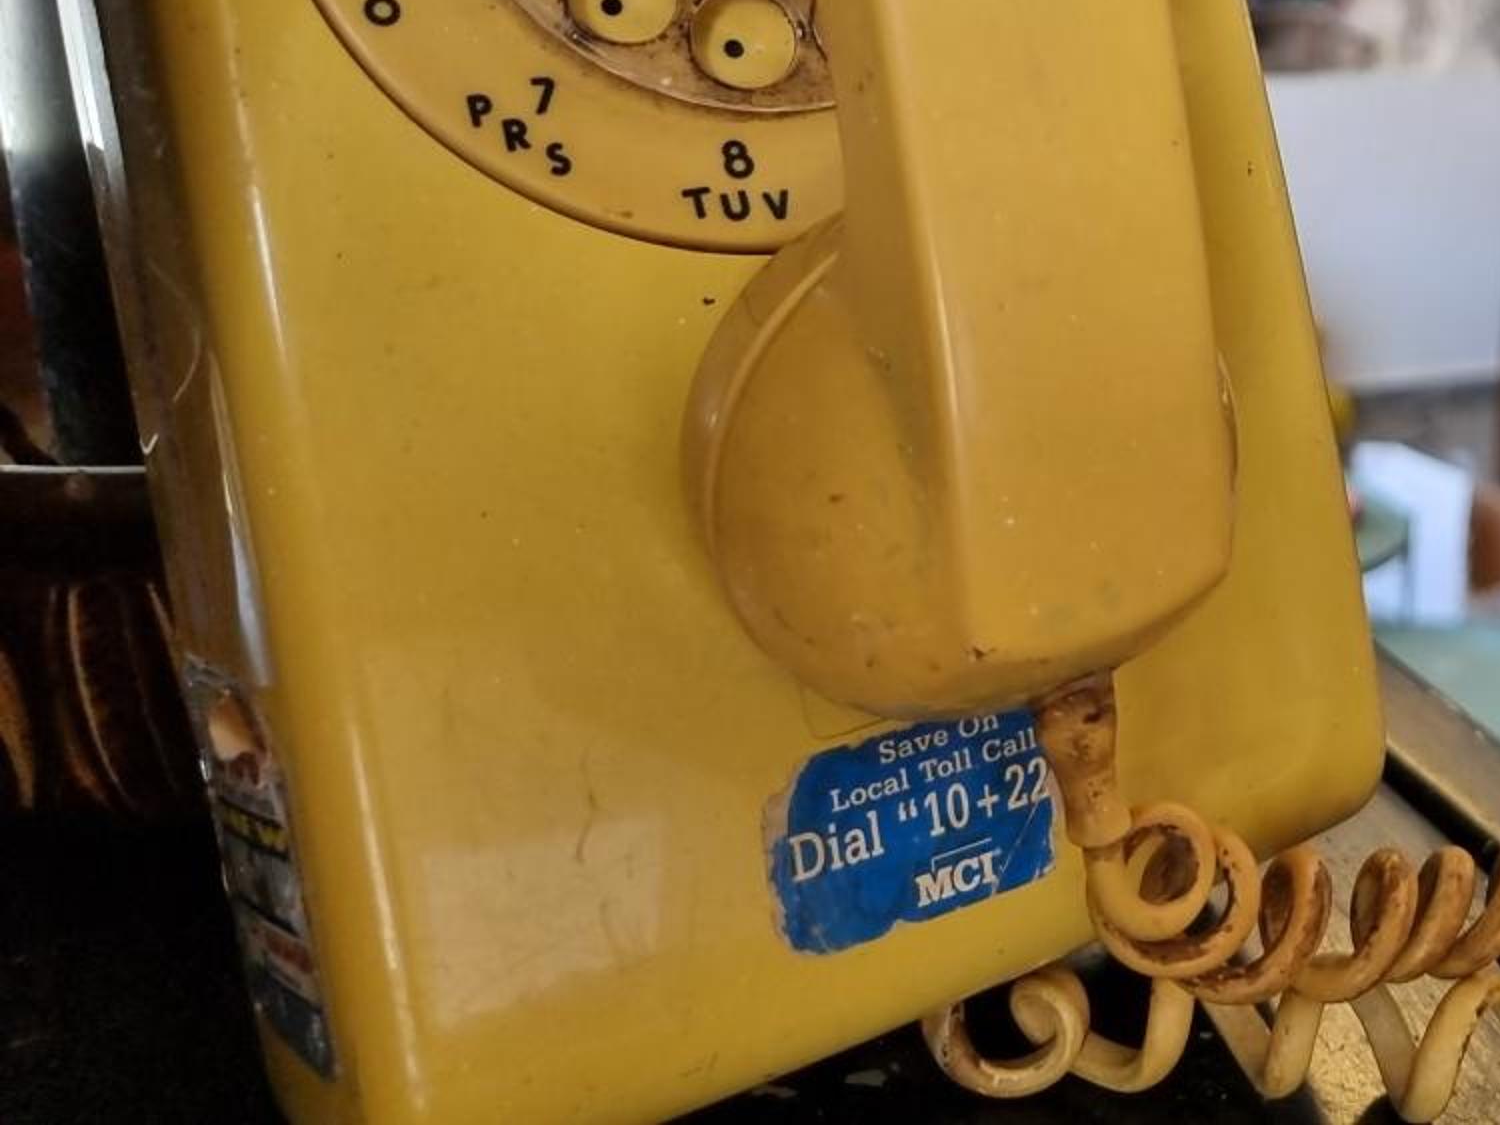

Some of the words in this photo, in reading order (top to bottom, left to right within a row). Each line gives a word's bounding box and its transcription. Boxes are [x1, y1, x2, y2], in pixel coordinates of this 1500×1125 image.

[530, 77, 556, 116] 7
[721, 140, 755, 180] 8
[878, 728, 949, 765] Save
[958, 713, 1000, 739] On
[830, 768, 911, 813] Local
[918, 749, 973, 785] Toll
[982, 726, 1039, 764] Call
[789, 810, 885, 883] Dial
[914, 850, 999, 908] MCI
